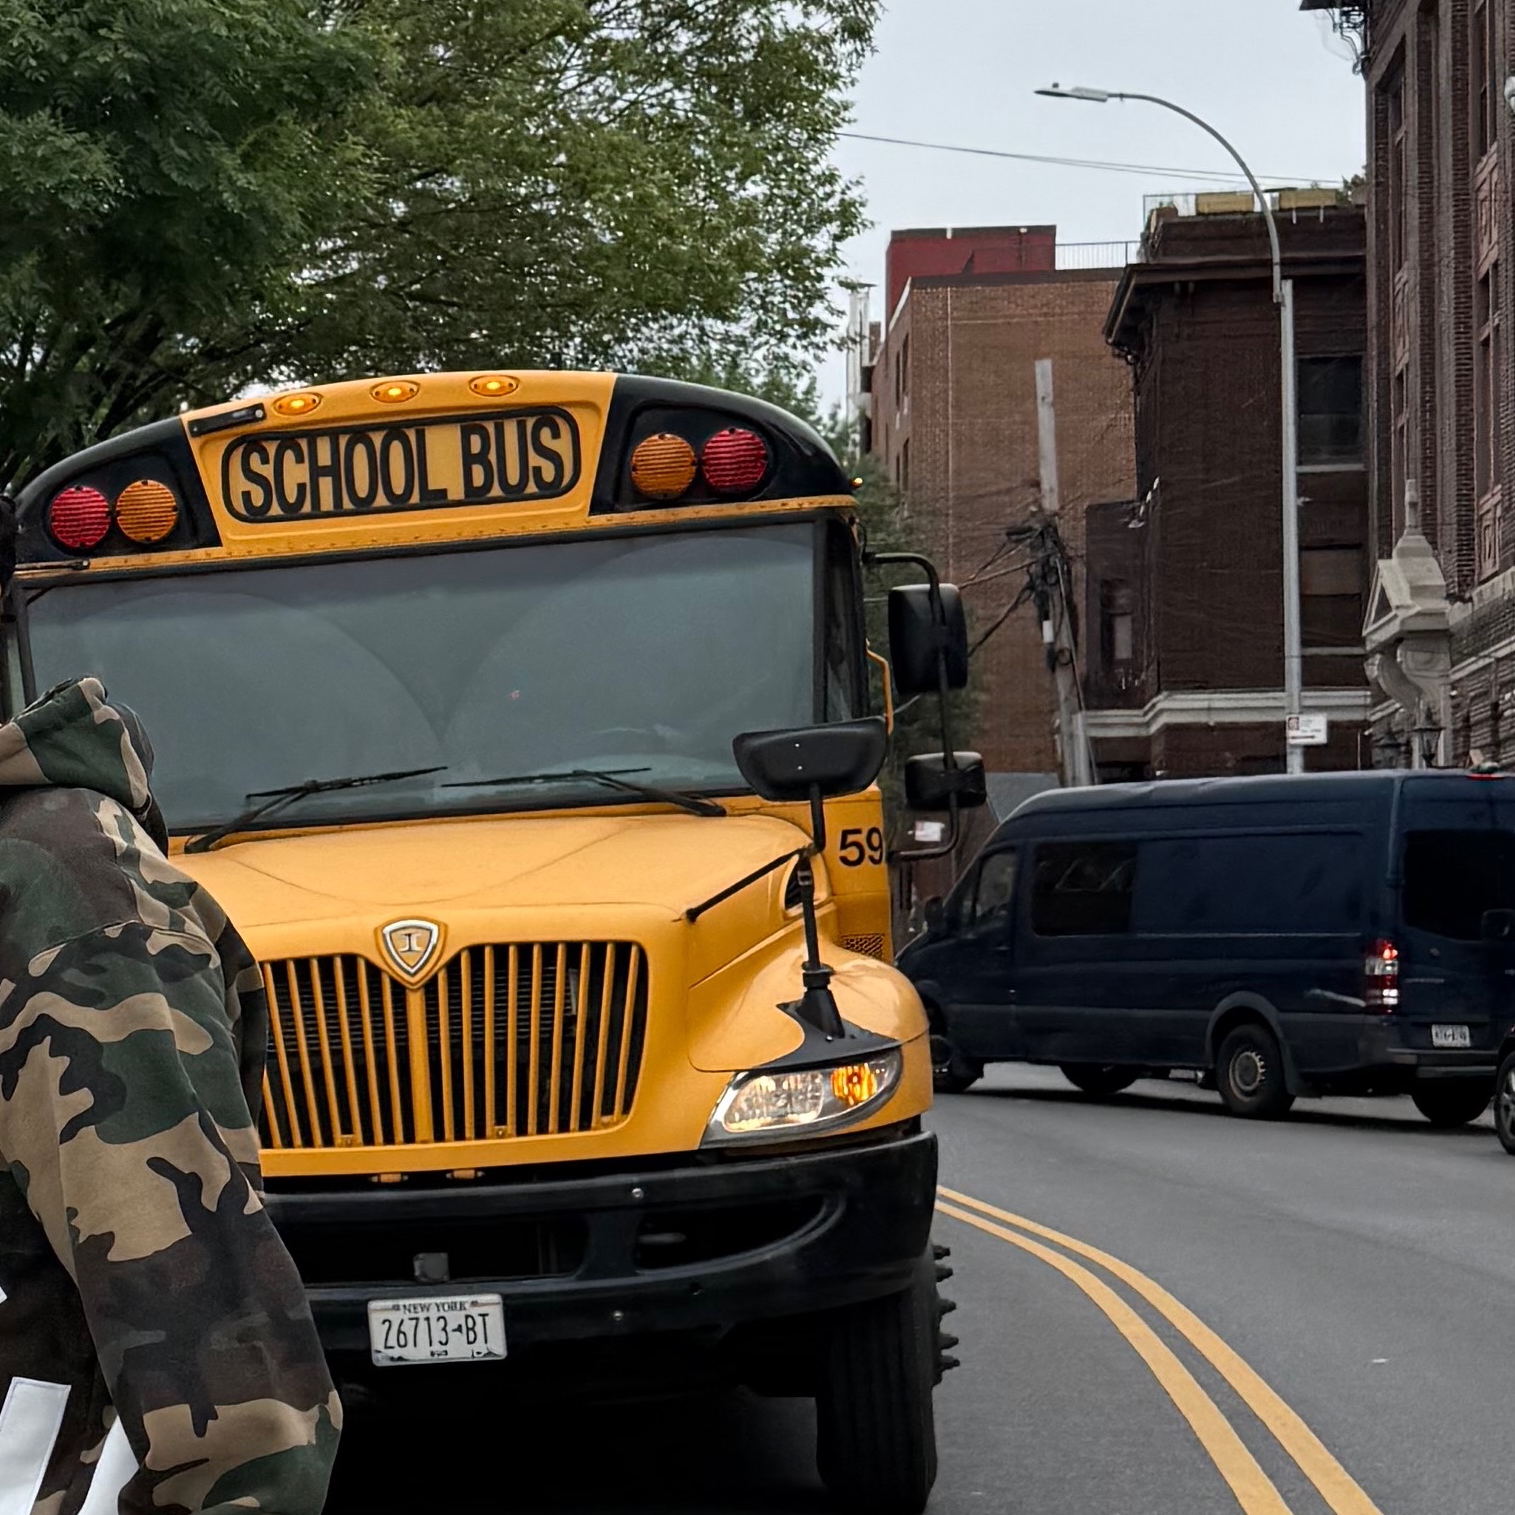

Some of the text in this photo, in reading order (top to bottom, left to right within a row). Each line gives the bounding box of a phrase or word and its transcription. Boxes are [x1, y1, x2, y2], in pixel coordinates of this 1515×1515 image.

[240, 416, 565, 517] SCHOOL BUS
[839, 827, 884, 867] 59
[403, 1301, 468, 1314] NEW YORK
